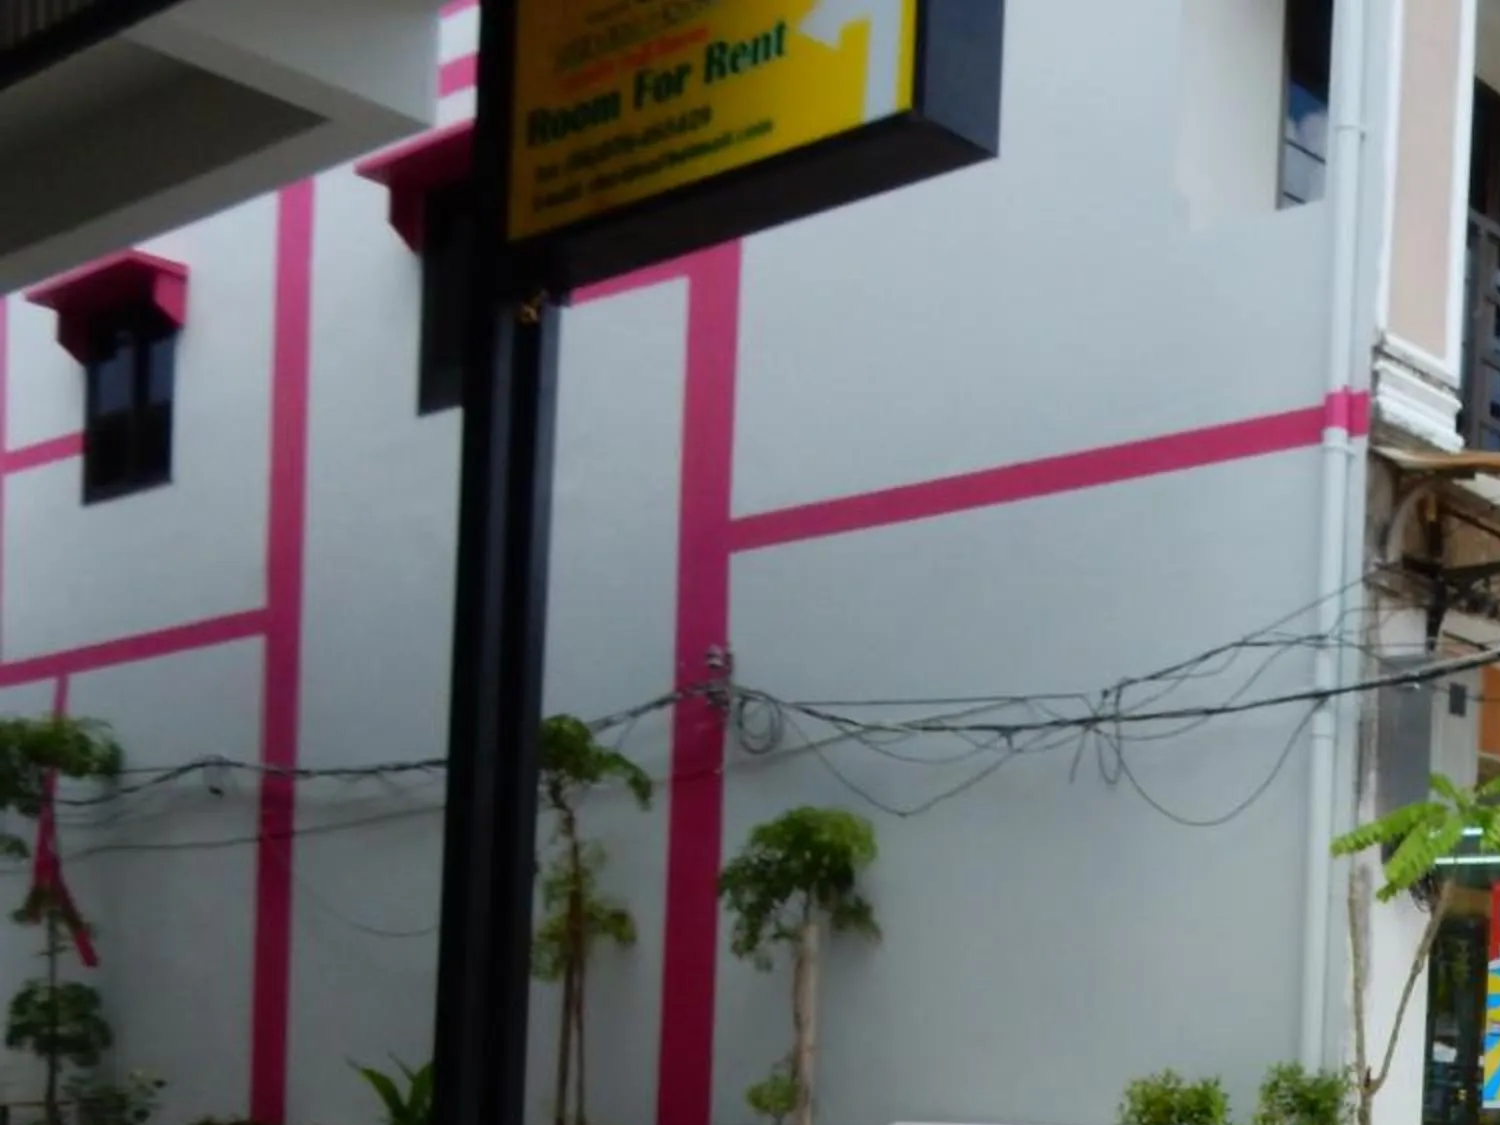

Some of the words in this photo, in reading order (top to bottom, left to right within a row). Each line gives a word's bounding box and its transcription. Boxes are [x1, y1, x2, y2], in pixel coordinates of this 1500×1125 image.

[527, 89, 621, 149] Room
[633, 61, 691, 109] For
[704, 21, 788, 84] Rent
